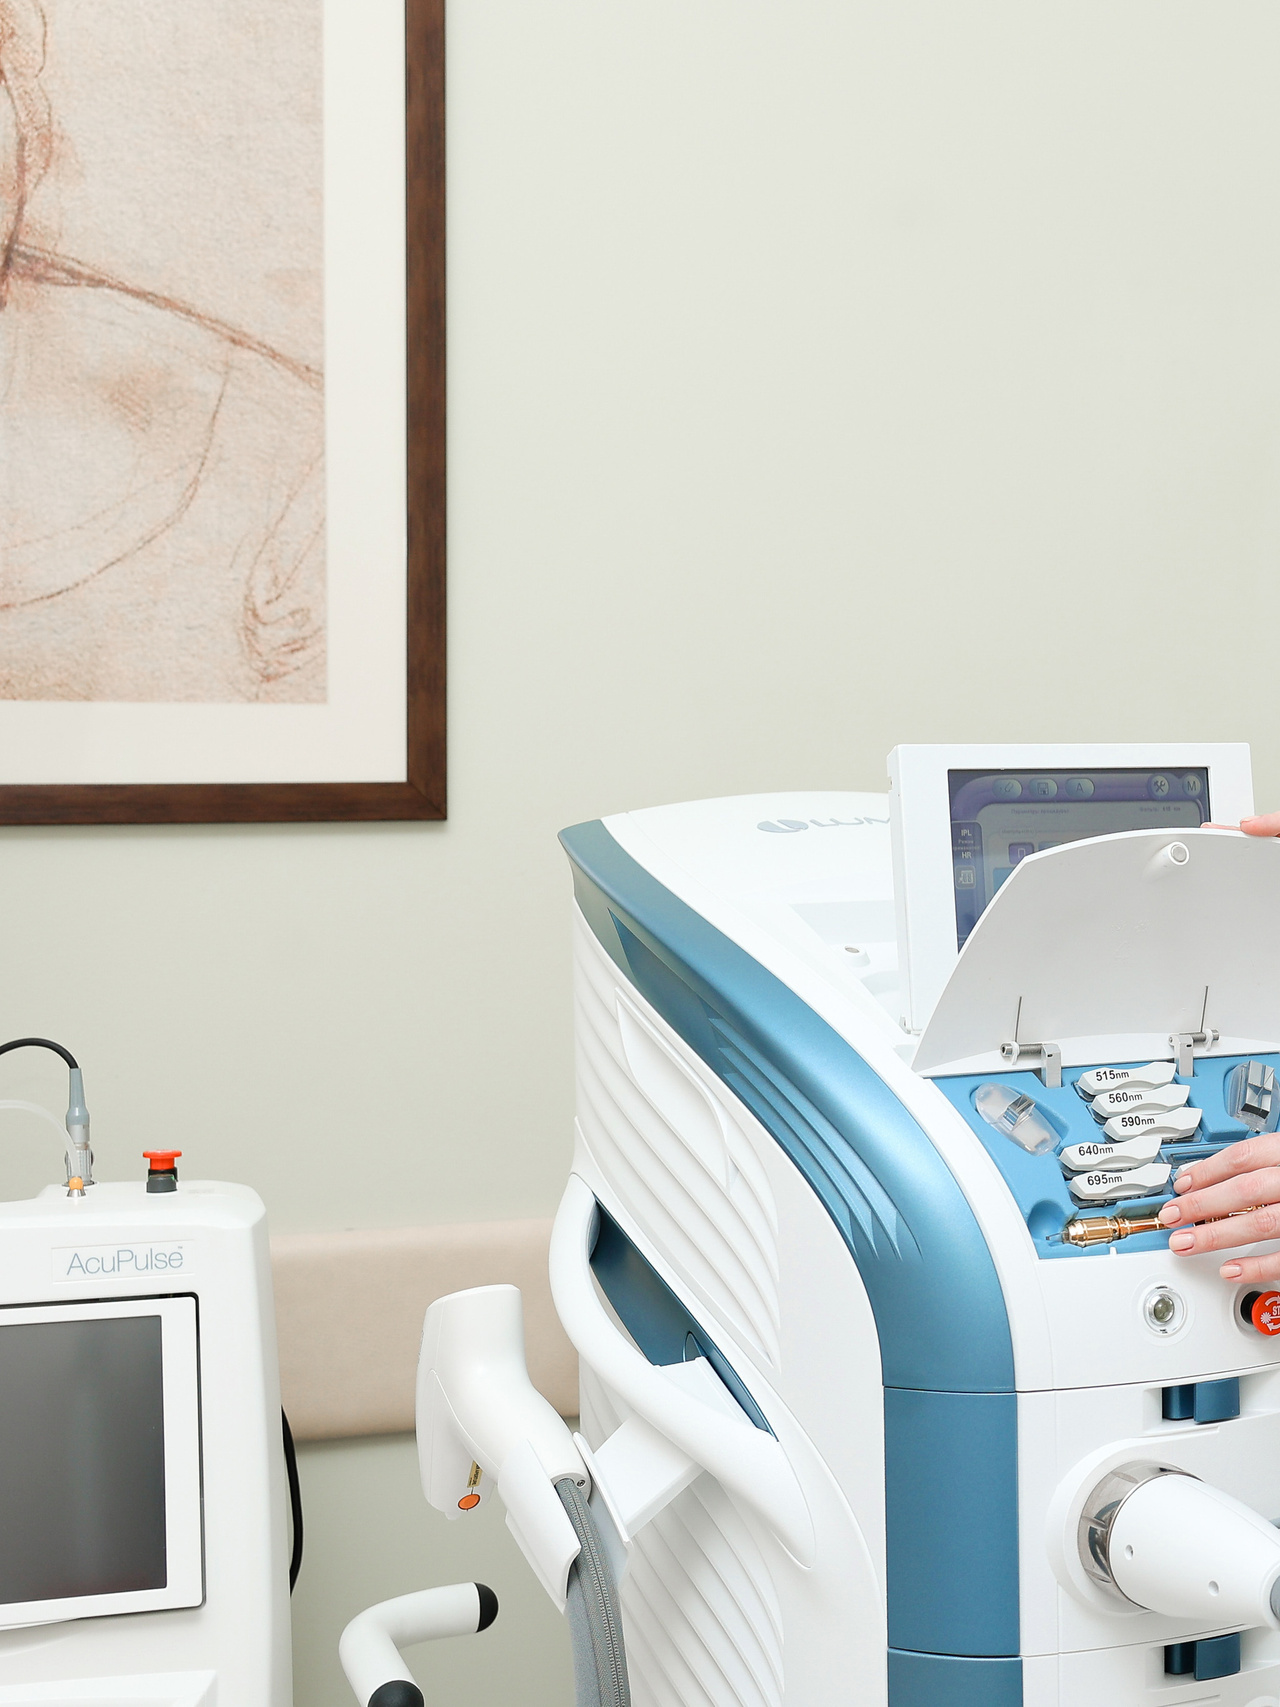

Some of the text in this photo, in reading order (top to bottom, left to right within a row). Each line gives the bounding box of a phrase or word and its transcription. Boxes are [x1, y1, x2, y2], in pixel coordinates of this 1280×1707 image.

[1095, 1069, 1129, 1082] 515nm
[1109, 1092, 1143, 1104] 560nm
[1121, 1115, 1155, 1127] 590nm
[1078, 1144, 1114, 1156] 640nm
[1087, 1173, 1122, 1186] 695nm
